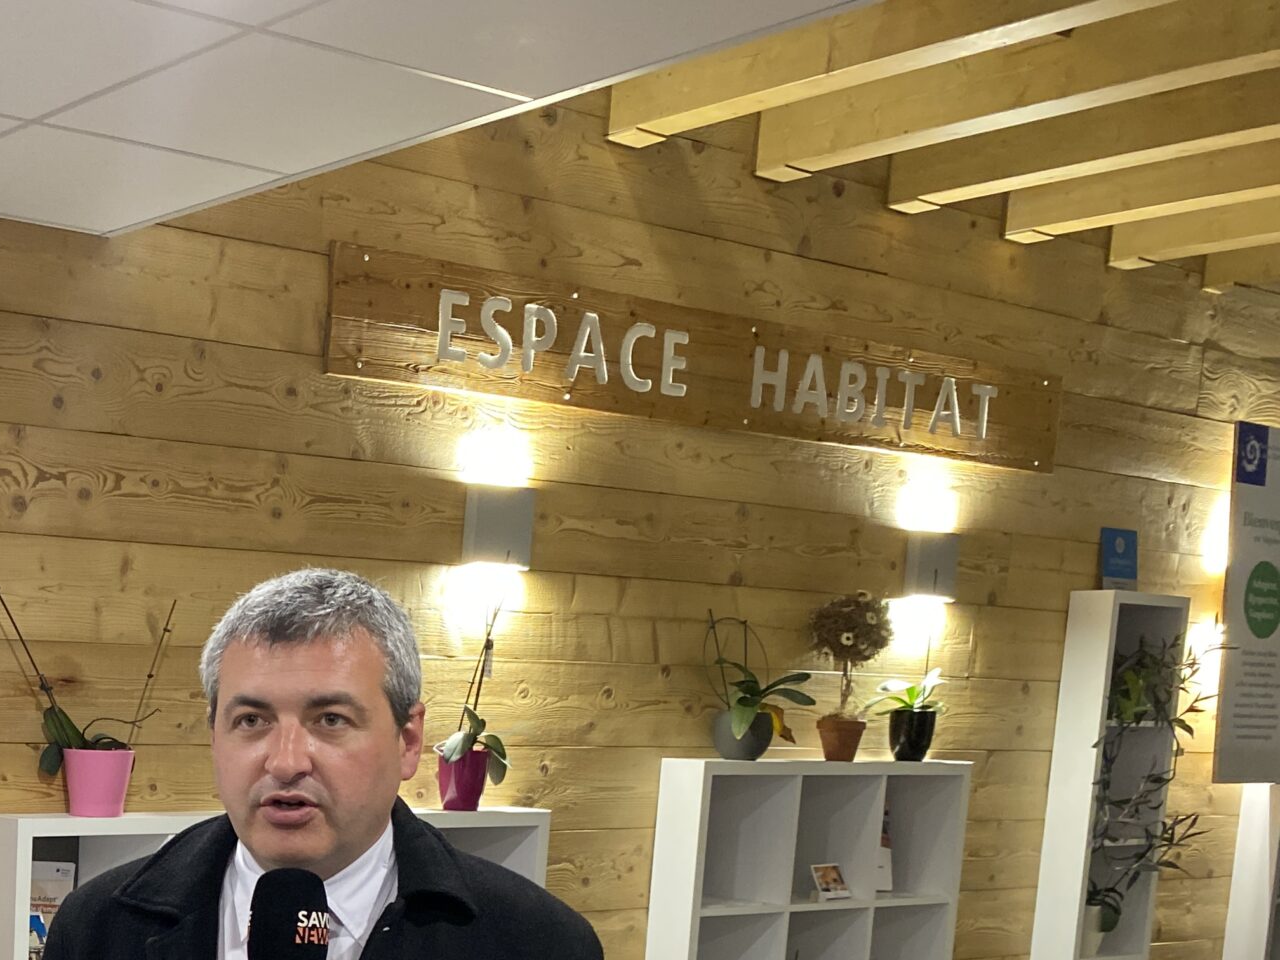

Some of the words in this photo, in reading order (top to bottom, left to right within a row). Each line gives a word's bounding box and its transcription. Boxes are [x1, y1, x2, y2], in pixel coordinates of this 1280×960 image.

[436, 289, 689, 398] ESPACE
[750, 345, 998, 441] HABITAT
[295, 927, 329, 945] NEW
